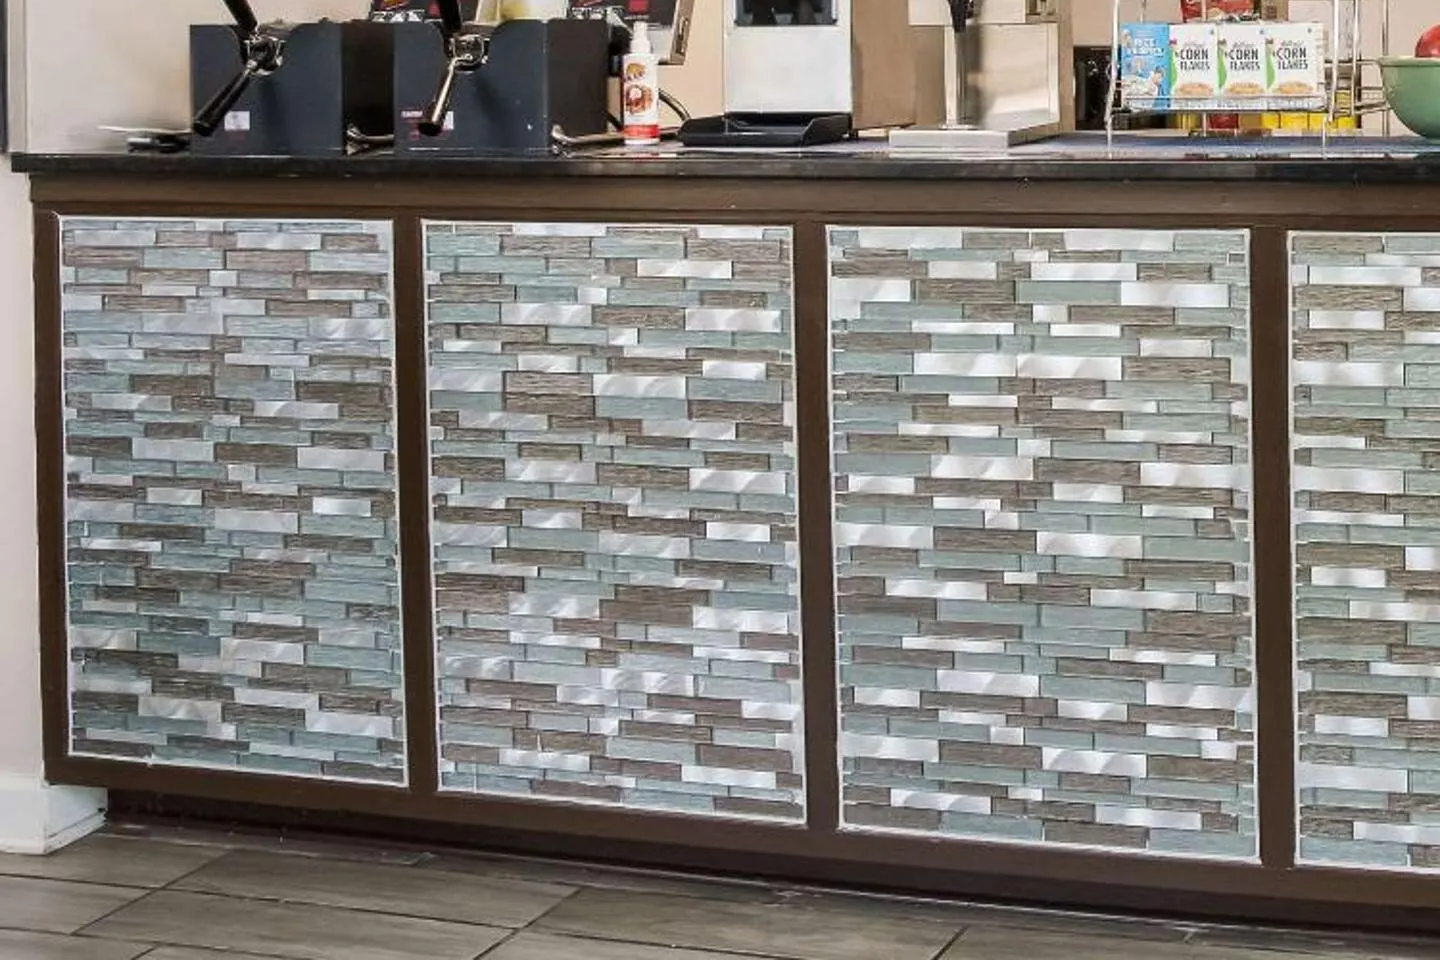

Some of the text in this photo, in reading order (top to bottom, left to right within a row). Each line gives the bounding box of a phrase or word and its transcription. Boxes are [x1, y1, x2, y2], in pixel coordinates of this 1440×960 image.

[1179, 48, 1209, 61] CORN
[1229, 48, 1259, 61] CORN
[1277, 46, 1307, 60] CORN
[1180, 60, 1211, 72] FLAKES
[1230, 60, 1261, 71] FLAKES
[1277, 59, 1309, 71] FLAKES
